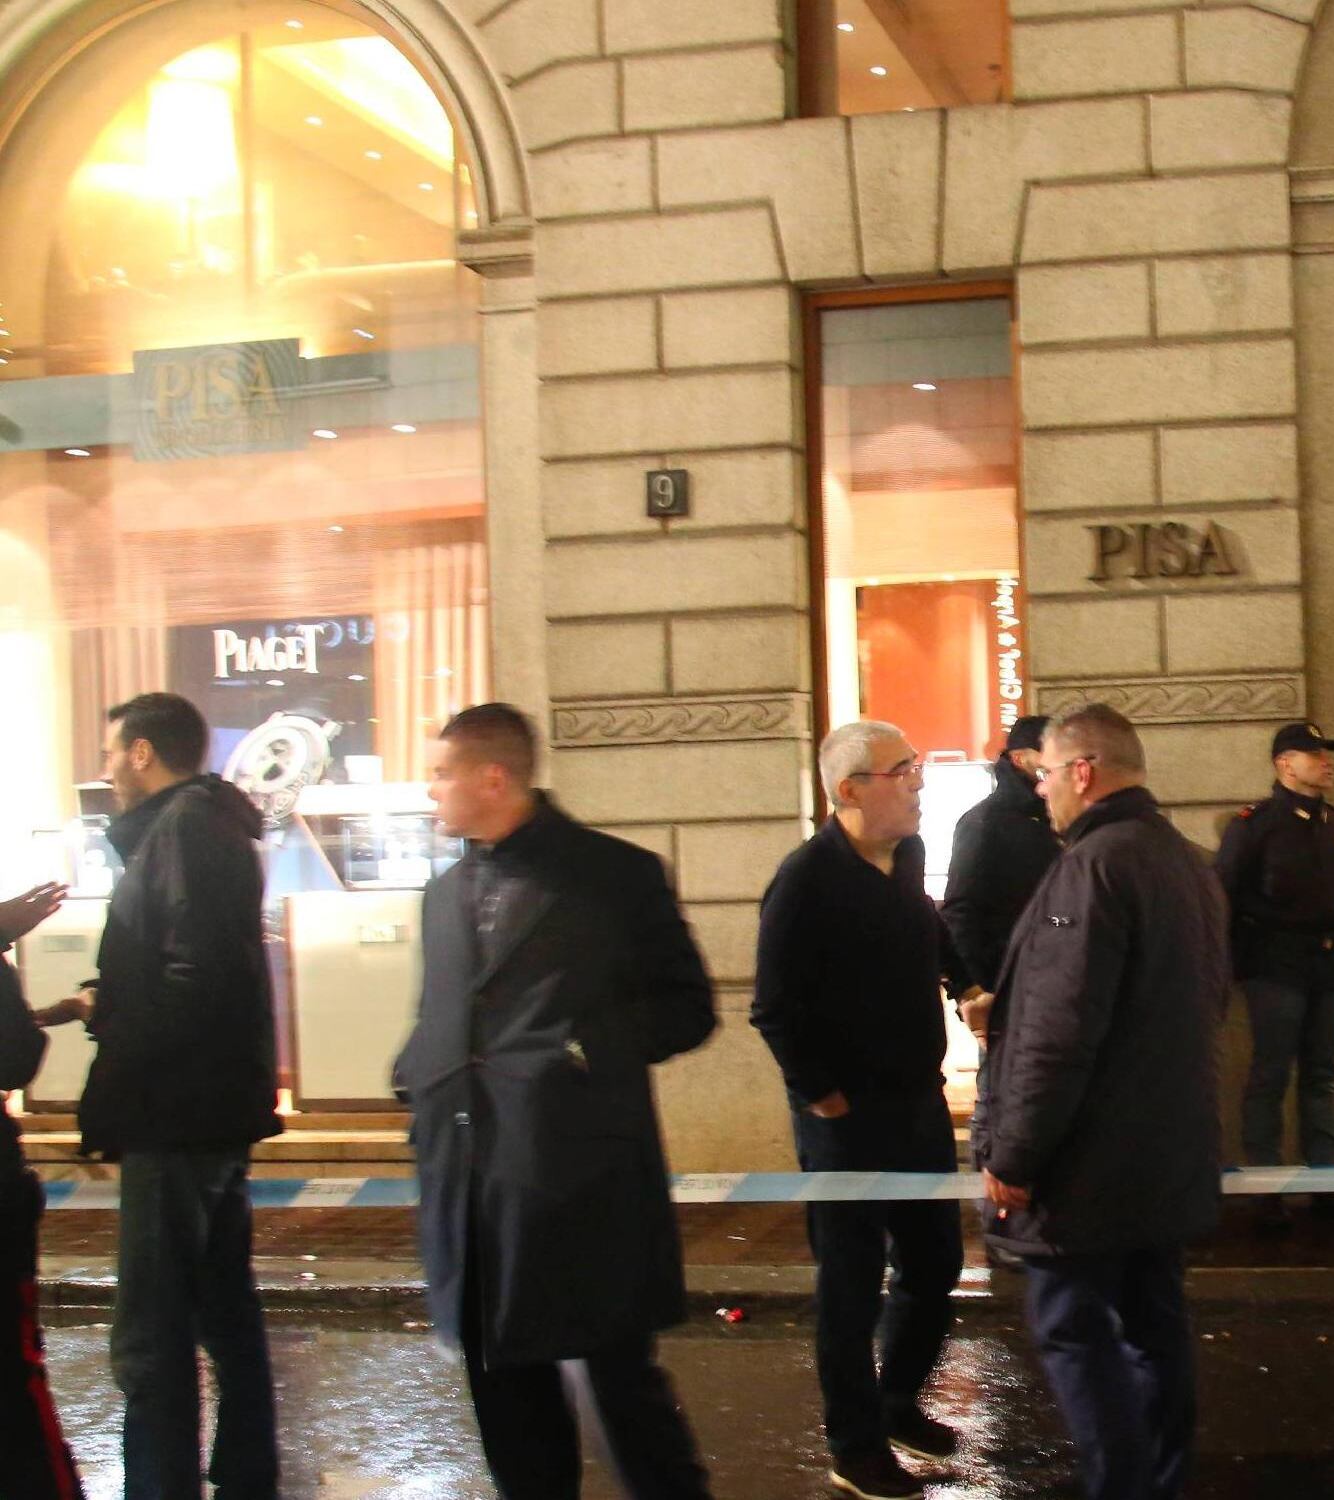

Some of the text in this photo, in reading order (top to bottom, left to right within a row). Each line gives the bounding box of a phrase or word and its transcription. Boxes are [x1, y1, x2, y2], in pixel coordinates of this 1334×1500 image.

[152, 351, 281, 421] PISA
[656, 475, 674, 508] 9
[1083, 520, 1239, 582] PISA
[212, 624, 324, 678] PIAGET
